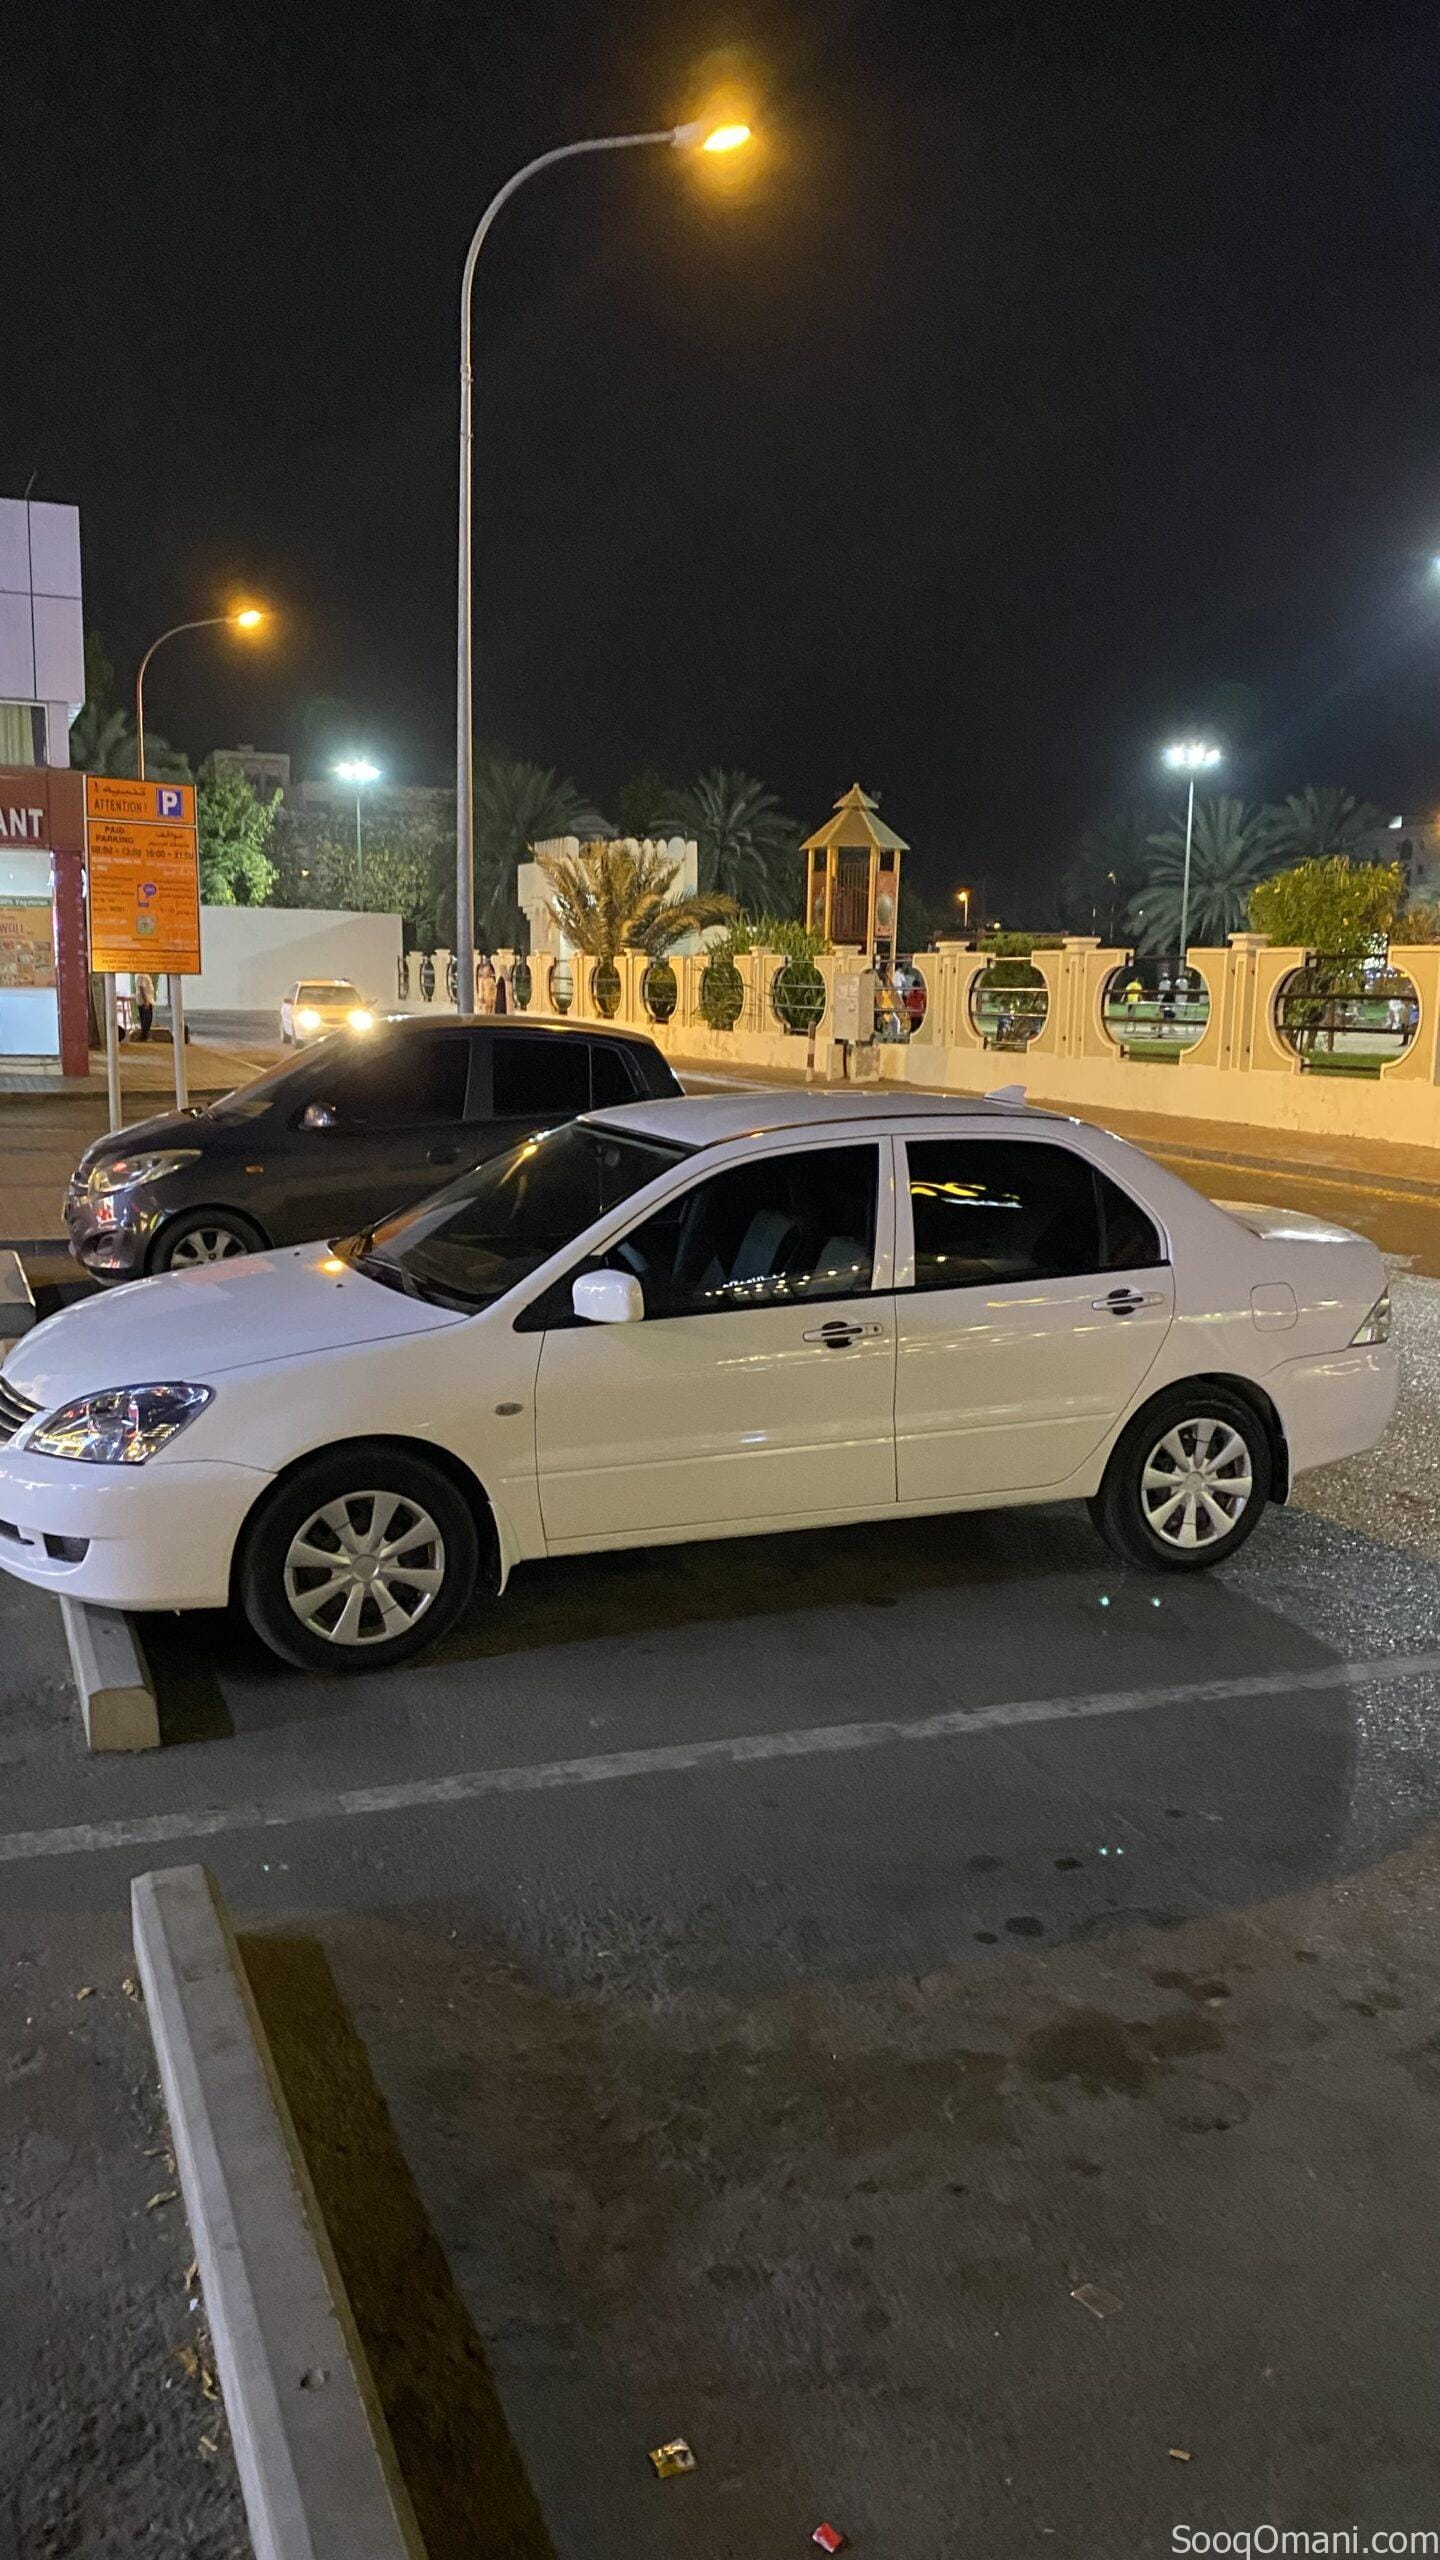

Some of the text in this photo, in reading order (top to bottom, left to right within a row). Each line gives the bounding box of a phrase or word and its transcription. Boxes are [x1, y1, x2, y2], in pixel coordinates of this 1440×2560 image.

[94, 799, 142, 813] ATTENTION
[162, 791, 178, 815] P
[104, 826, 125, 834] PAID
[96, 834, 134, 844] PARKING
